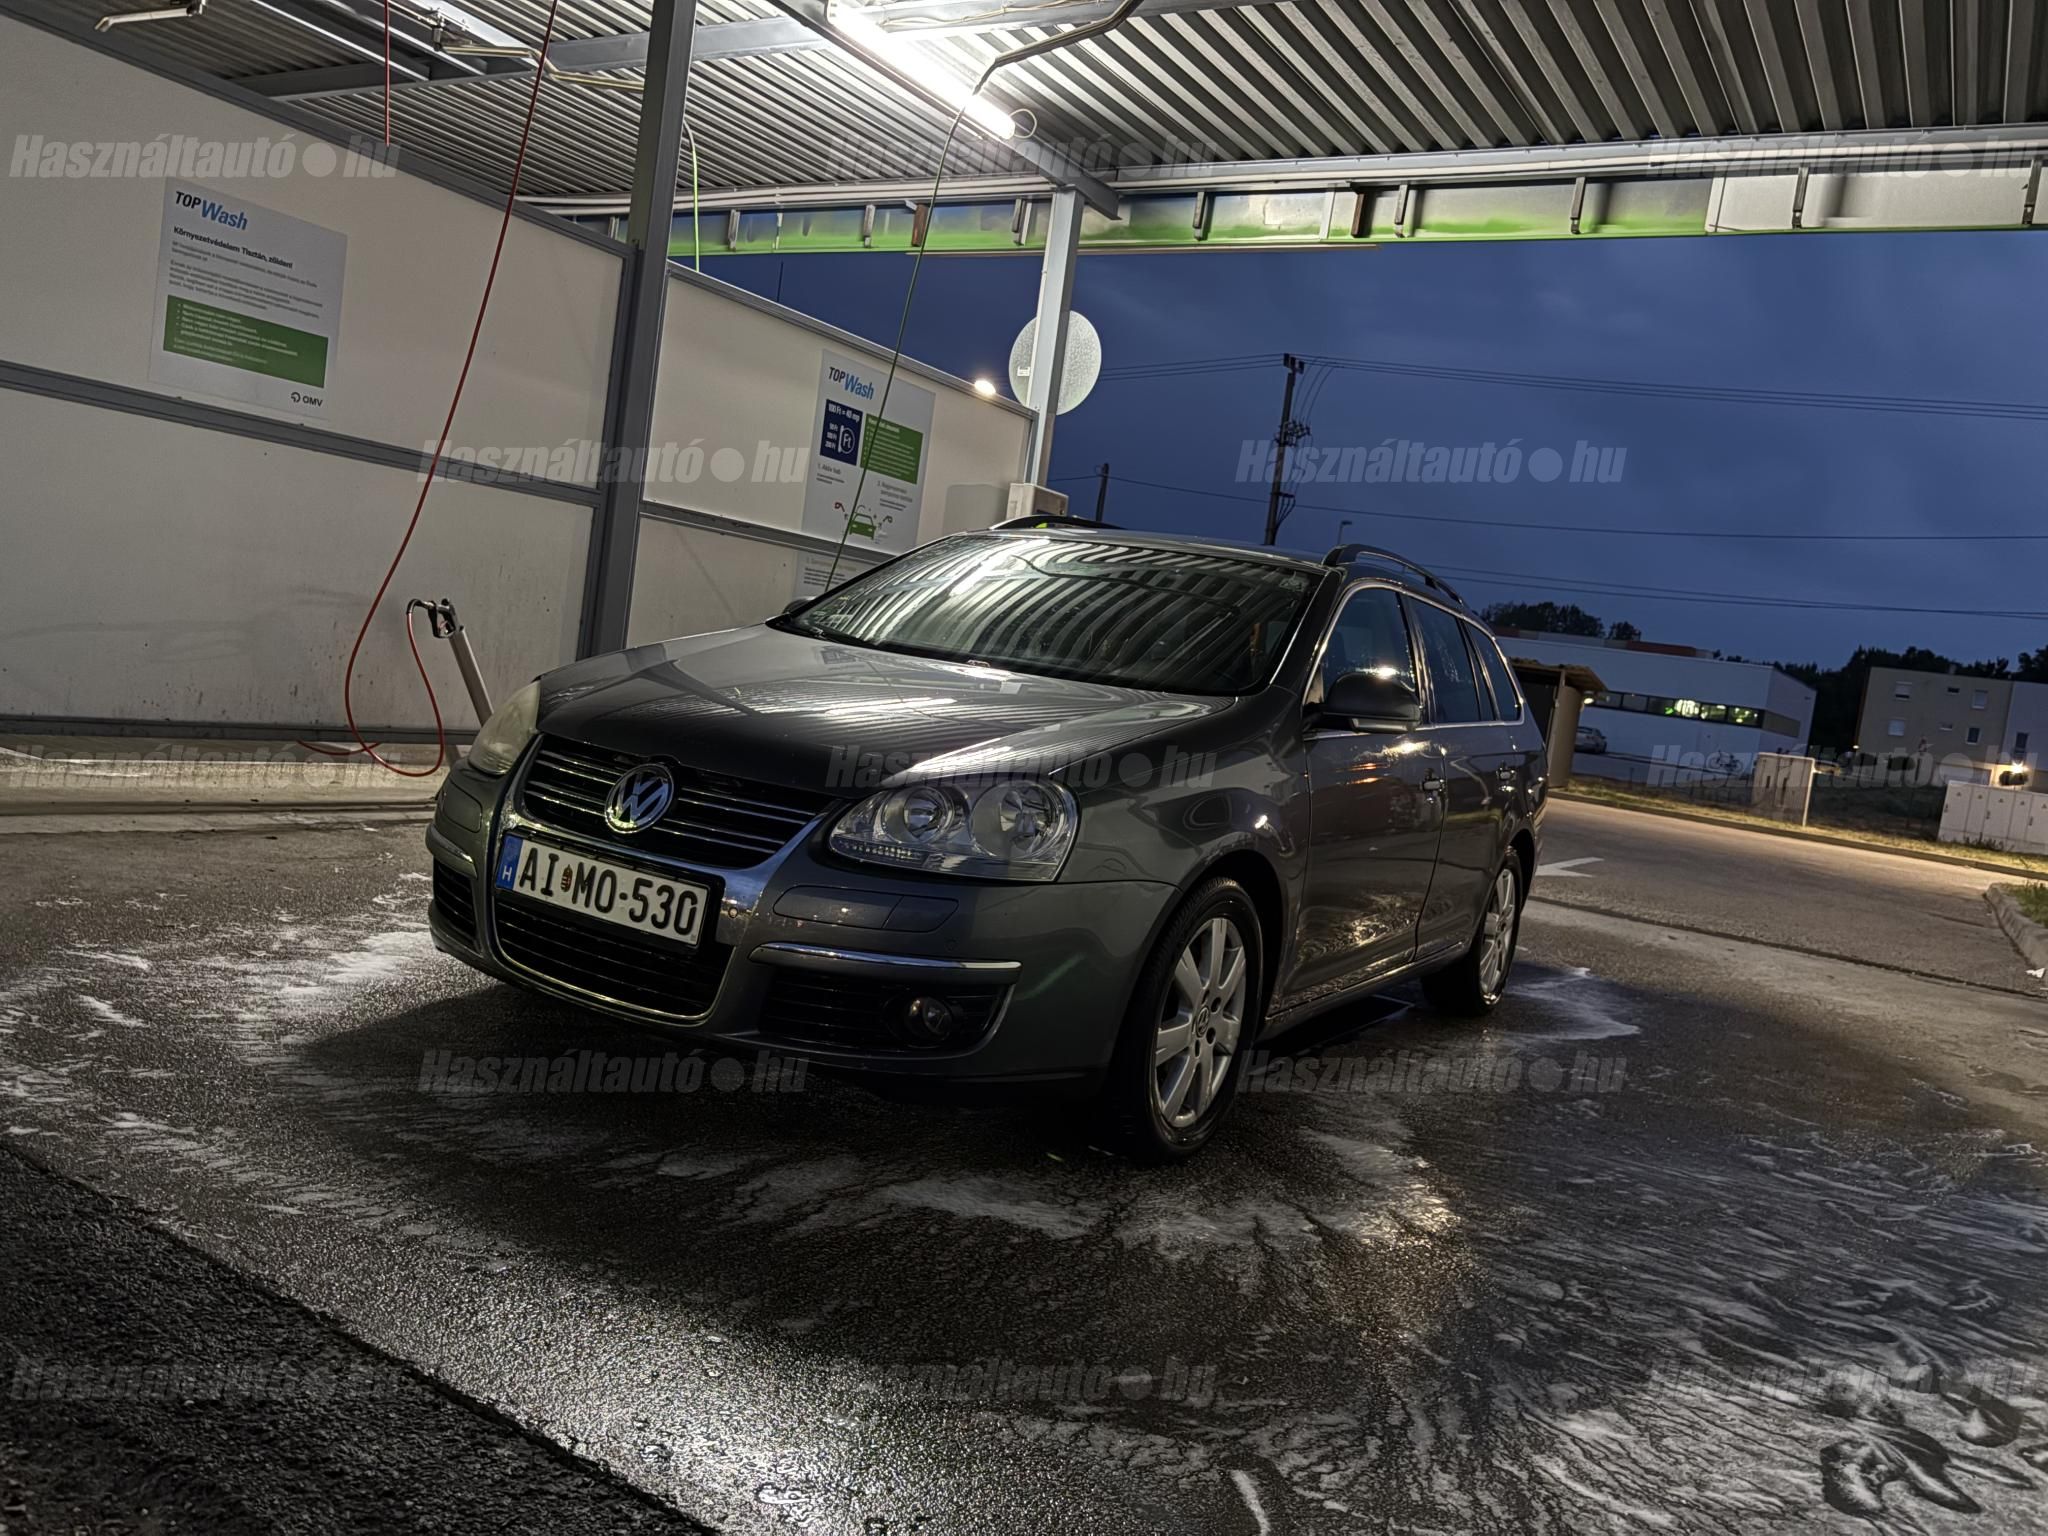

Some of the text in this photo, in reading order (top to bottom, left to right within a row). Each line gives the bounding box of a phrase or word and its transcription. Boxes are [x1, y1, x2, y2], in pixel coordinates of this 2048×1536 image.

[174, 191, 248, 231] TOP Wash
[302, 394, 324, 408] OMV
[828, 366, 874, 401] TOP Wash
[502, 847, 699, 936] H AI MO-530
